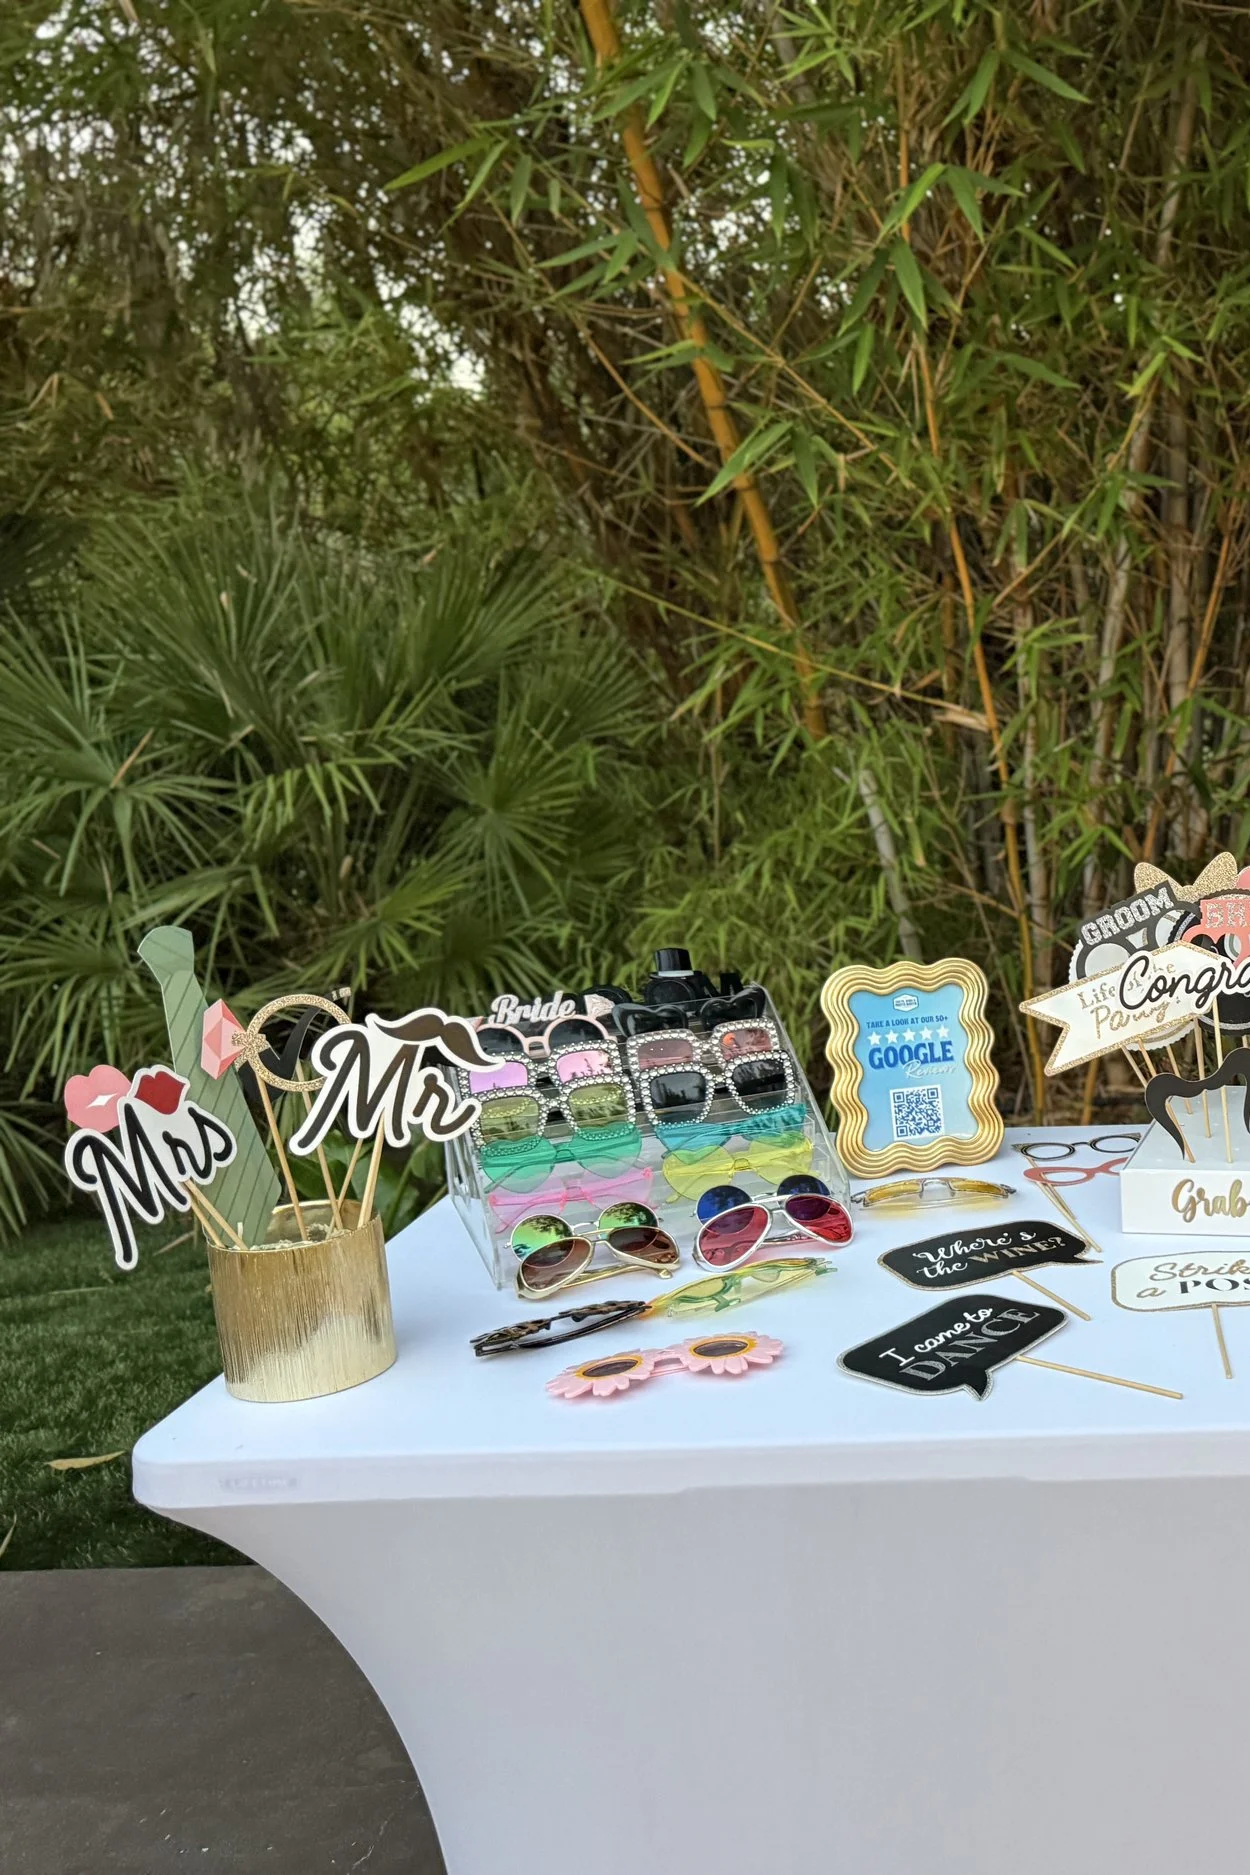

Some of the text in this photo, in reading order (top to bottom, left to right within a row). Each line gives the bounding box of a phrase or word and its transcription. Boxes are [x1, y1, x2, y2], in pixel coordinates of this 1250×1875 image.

[1081, 887, 1174, 946] GROOM
[489, 991, 577, 1025] Bride
[1076, 981, 1117, 1010] Life
[866, 1021, 884, 1029] TAKE
[891, 1018, 909, 1027] LOOK
[910, 1017, 920, 1025] AT
[920, 1015, 934, 1024] OUR
[935, 1014, 948, 1023] 50+
[868, 1040, 954, 1070] GOOGLE
[902, 1059, 956, 1078] Reviews
[298, 1030, 478, 1150] Mr
[73, 1103, 232, 1263] Mrs
[912, 1231, 1037, 1263] Where's
[916, 1236, 1067, 1279] the WINE?
[1136, 1287, 1167, 1298] a
[878, 1307, 994, 1367] I came to
[899, 1308, 1041, 1382] DANCE
